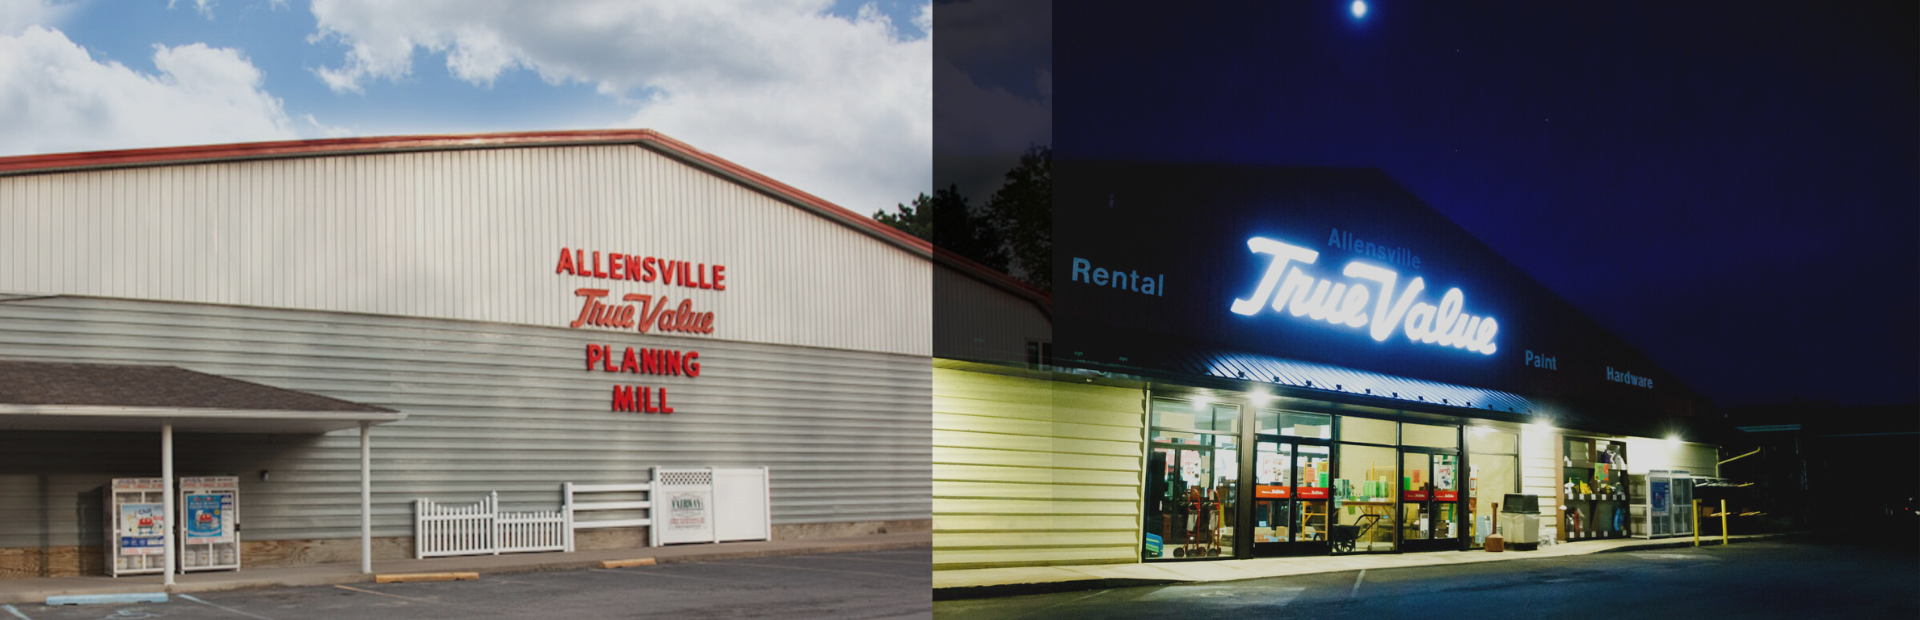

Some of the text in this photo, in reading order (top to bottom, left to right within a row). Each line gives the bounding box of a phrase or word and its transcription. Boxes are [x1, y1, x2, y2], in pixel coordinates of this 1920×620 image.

[556, 247, 726, 291] ALLENSVILLE
[1327, 228, 1422, 270] Allensville
[1071, 256, 1164, 297] Rental
[1230, 236, 1498, 356] True Value
[570, 288, 715, 335] True Value
[586, 343, 700, 378] PLANING
[1525, 350, 1557, 371] Paint
[1606, 366, 1653, 389] Hardware
[612, 384, 674, 414] MILL
